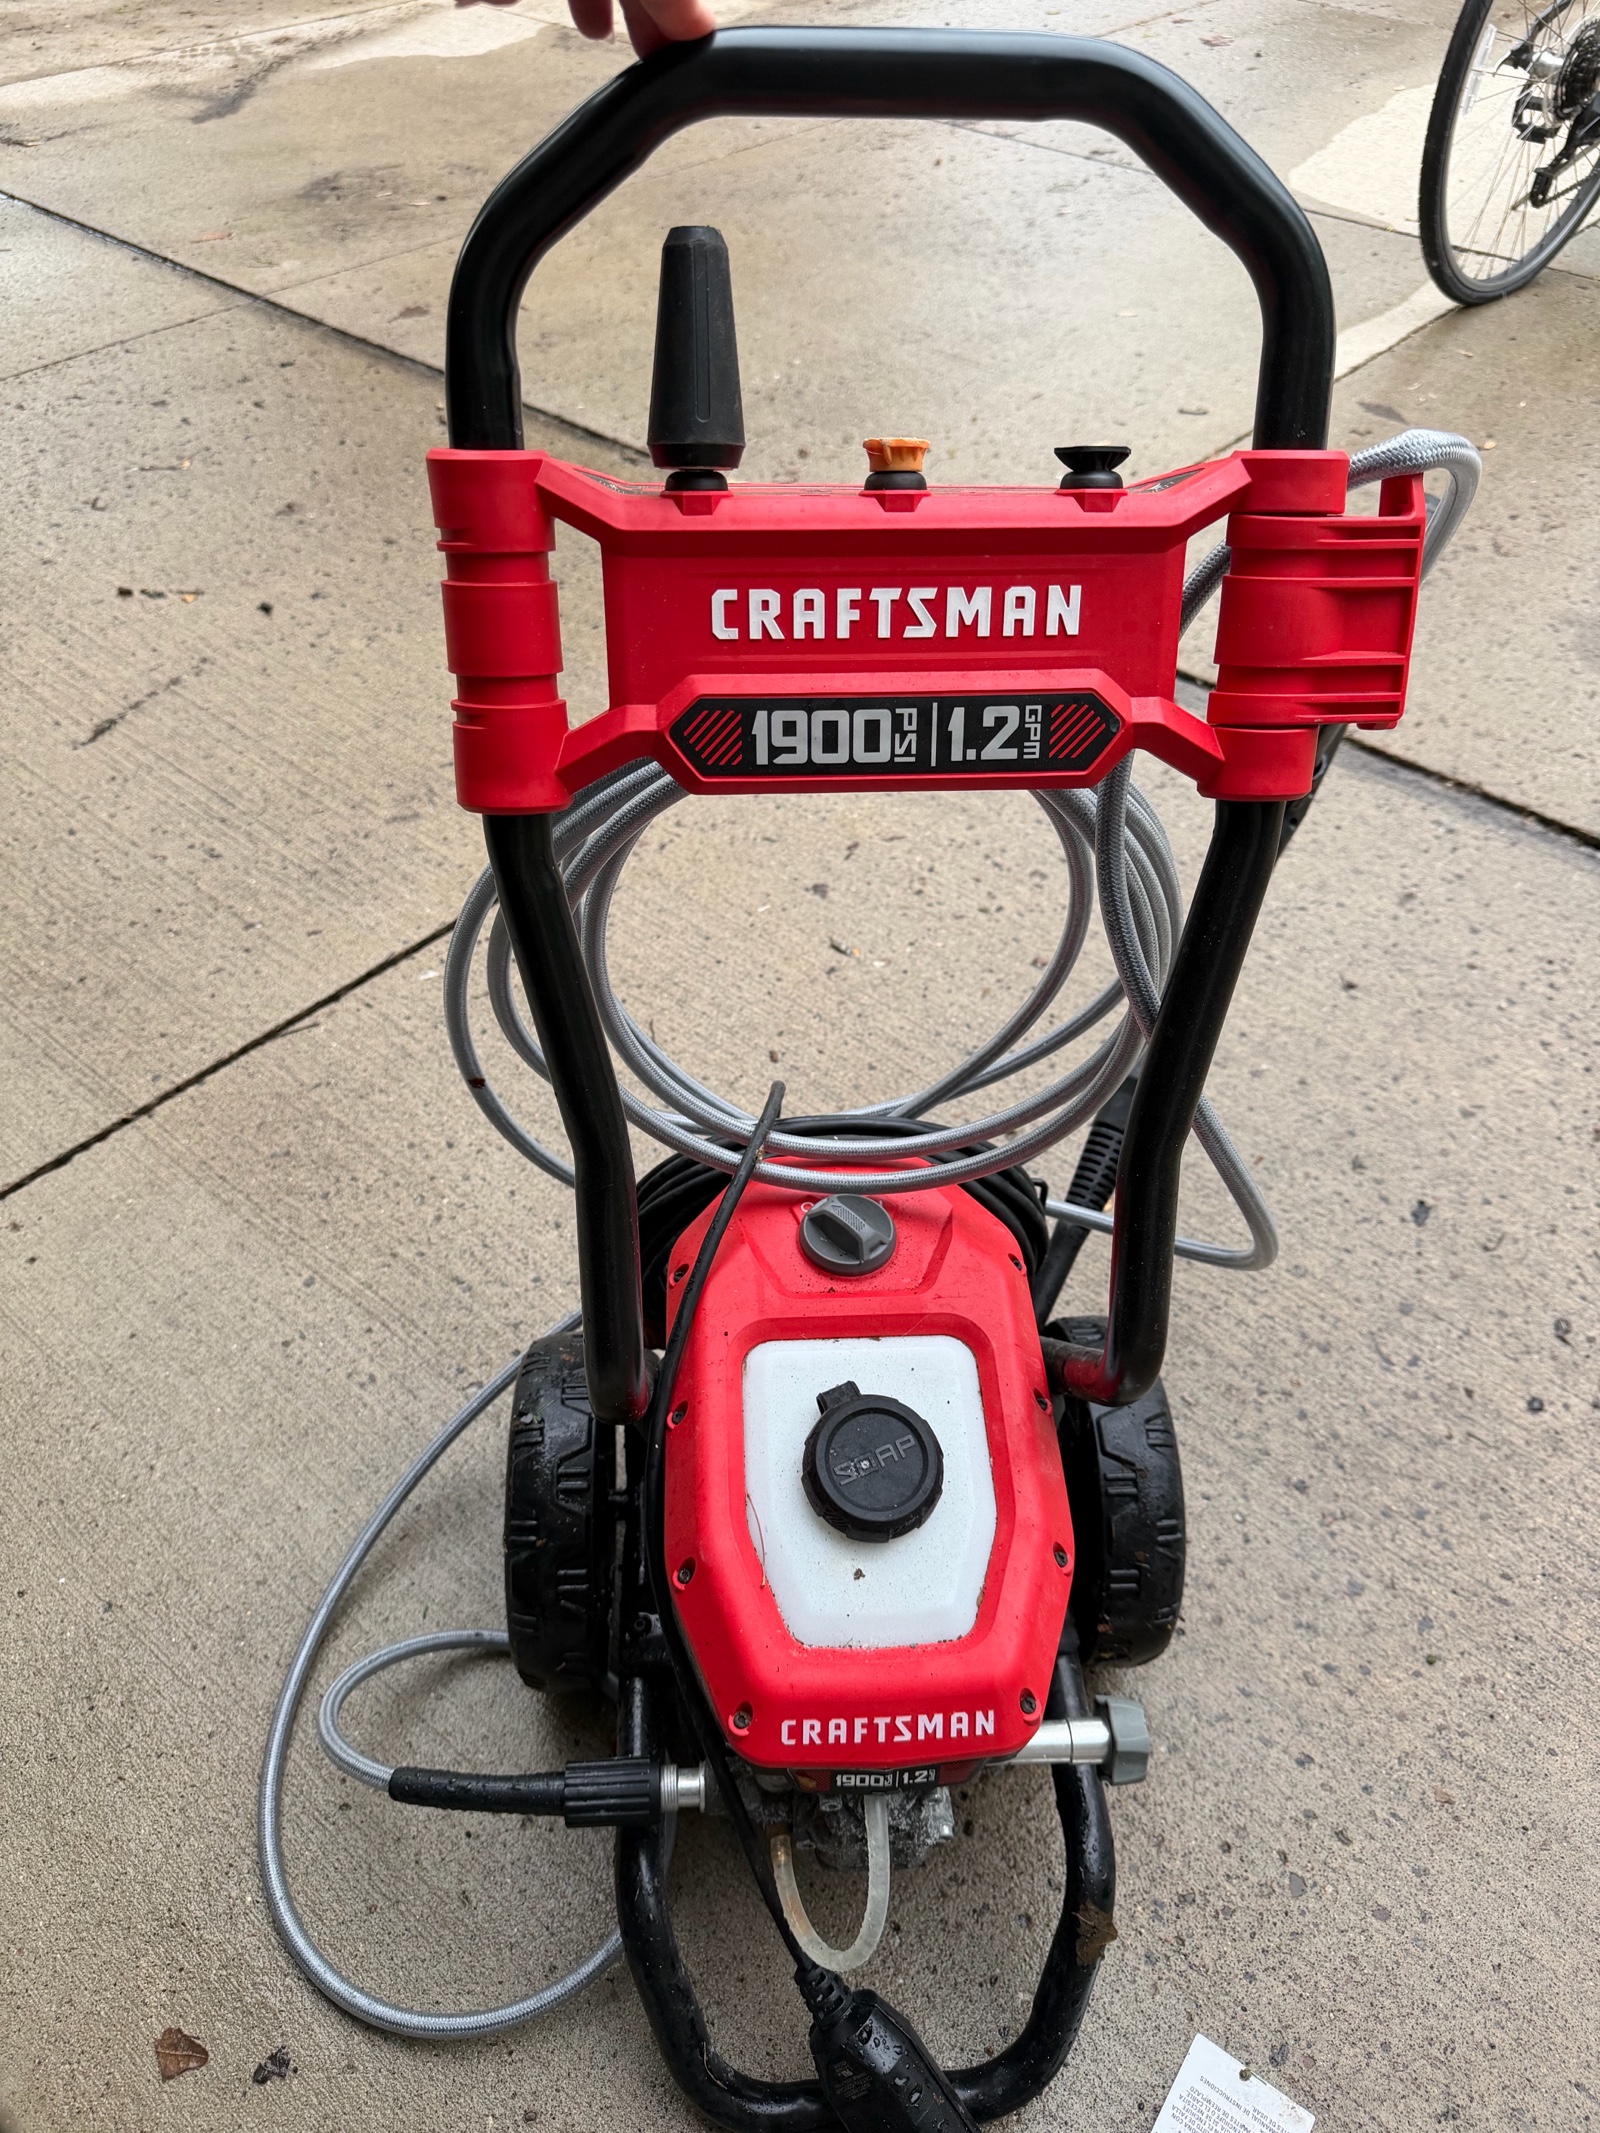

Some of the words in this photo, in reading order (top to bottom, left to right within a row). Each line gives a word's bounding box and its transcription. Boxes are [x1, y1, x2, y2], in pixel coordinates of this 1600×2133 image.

[712, 585, 1081, 639] CRAFTSMAN
[752, 709, 891, 764] 1900
[894, 708, 917, 762] PSI
[948, 706, 1019, 761] 1.2
[1023, 705, 1042, 758] GPM
[833, 1434, 916, 1486] SOAP
[781, 1709, 995, 1745] CRAFTSMAN
[836, 1774, 884, 1787] 1900
[903, 1770, 928, 1784] 1.2
[1189, 2086, 1222, 2113] REEMPLAZO
[1200, 2076, 1242, 2110] INSTRUCCIONES
[1172, 2104, 1188, 2120] FALLA
[1179, 2093, 1205, 2116] NECESITA
[1205, 2104, 1211, 2113] EL
[1243, 2108, 1251, 2116] DE
[1171, 2112, 1184, 2125] CON
[1182, 2105, 1207, 2126] ENCHUFE
[1188, 2117, 1196, 2126] DE
[1205, 2114, 1212, 2122] SE
[1222, 2110, 1230, 2119] DE
[1269, 2119, 1277, 2128] DE
